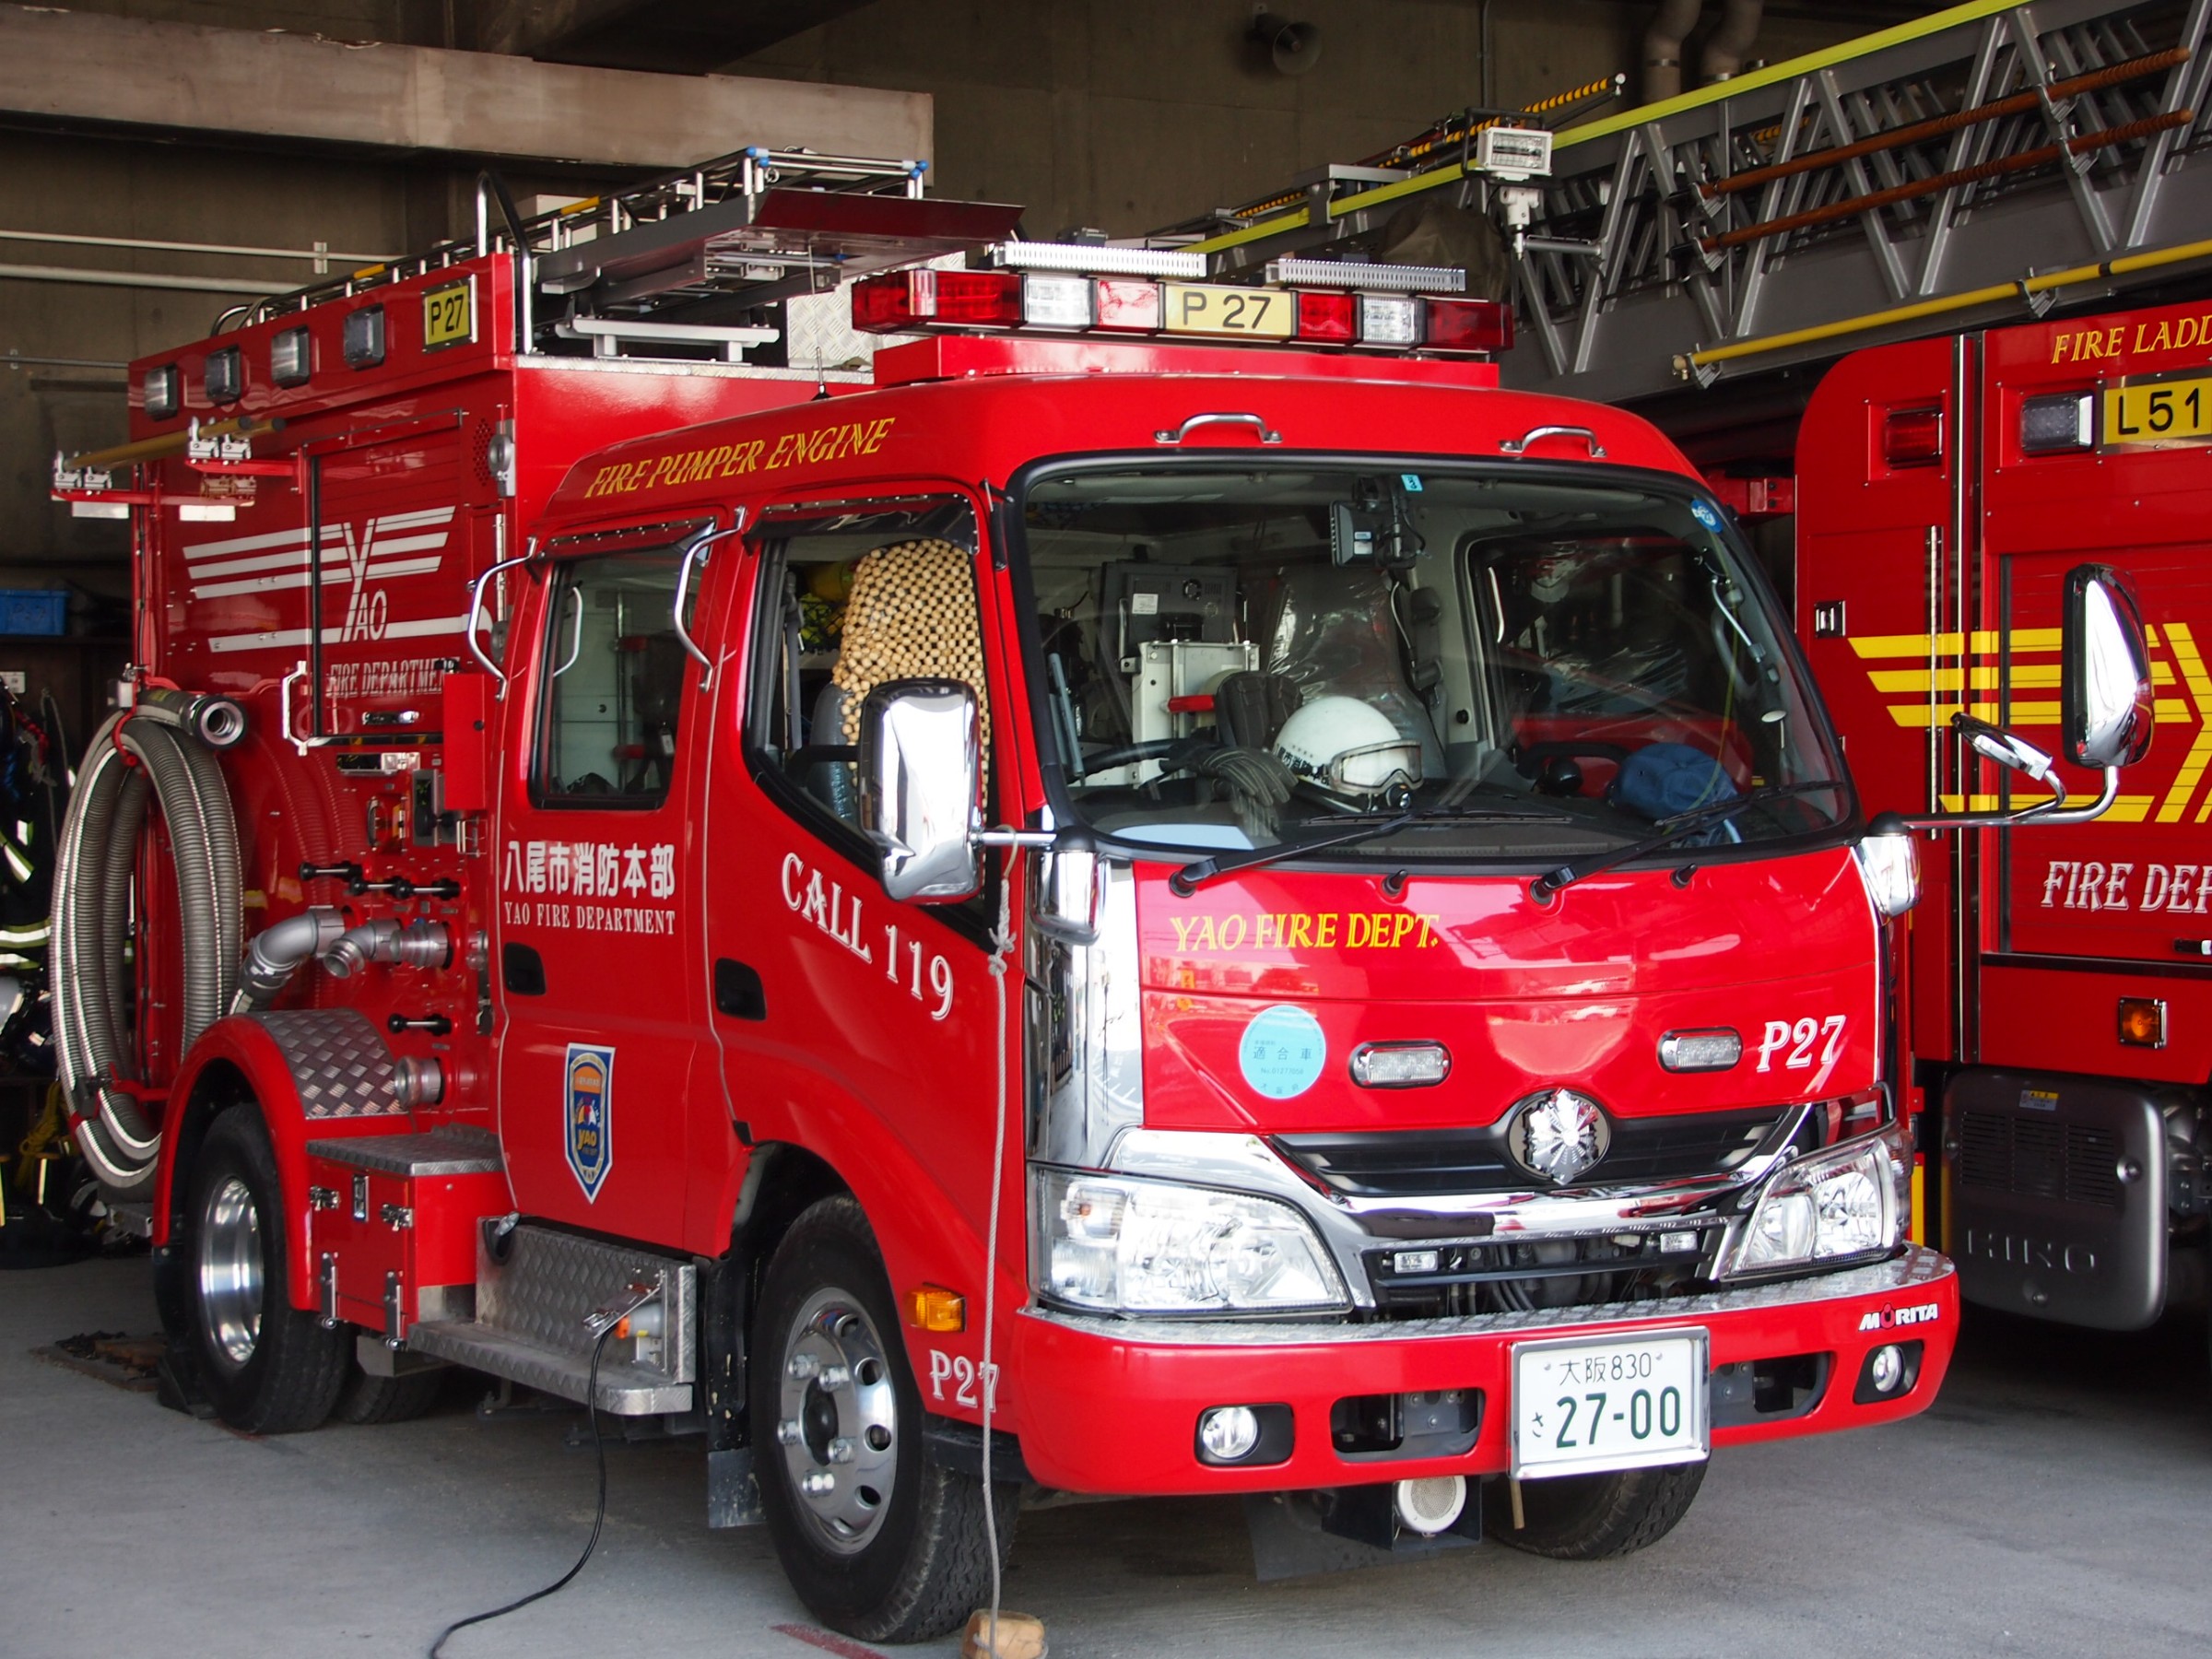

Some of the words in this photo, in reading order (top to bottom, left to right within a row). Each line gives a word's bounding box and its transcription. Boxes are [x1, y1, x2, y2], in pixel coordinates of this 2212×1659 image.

[1182, 291, 1206, 325] P
[1222, 294, 1271, 329] 27
[2051, 326, 2125, 364] FIRE
[2119, 387, 2199, 435] L51
[584, 459, 652, 499] FIRE
[646, 440, 766, 488] PUMPER
[764, 418, 896, 470] ENGINE
[342, 518, 387, 643] YAO
[326, 662, 360, 698] FIRE
[360, 656, 460, 697] DEPARTME
[503, 841, 676, 900] 八尾市消防本部
[2041, 861, 2135, 912] FIRE
[504, 901, 531, 925] YAO
[536, 903, 571, 928] FIRE
[576, 905, 676, 935] DEPARTMENT
[782, 852, 873, 964] CALL
[885, 924, 954, 1020] 119
[1170, 913, 1247, 952] YAO
[1253, 912, 1338, 948] FIRE
[1346, 912, 1440, 948] DEPT.
[1756, 1014, 1847, 1073] P27
[1858, 1302, 1939, 1331] MORITA
[929, 1348, 1000, 1413] P27
[1531, 1411, 1545, 1439] さ
[1556, 1385, 1680, 1449] 27-00
